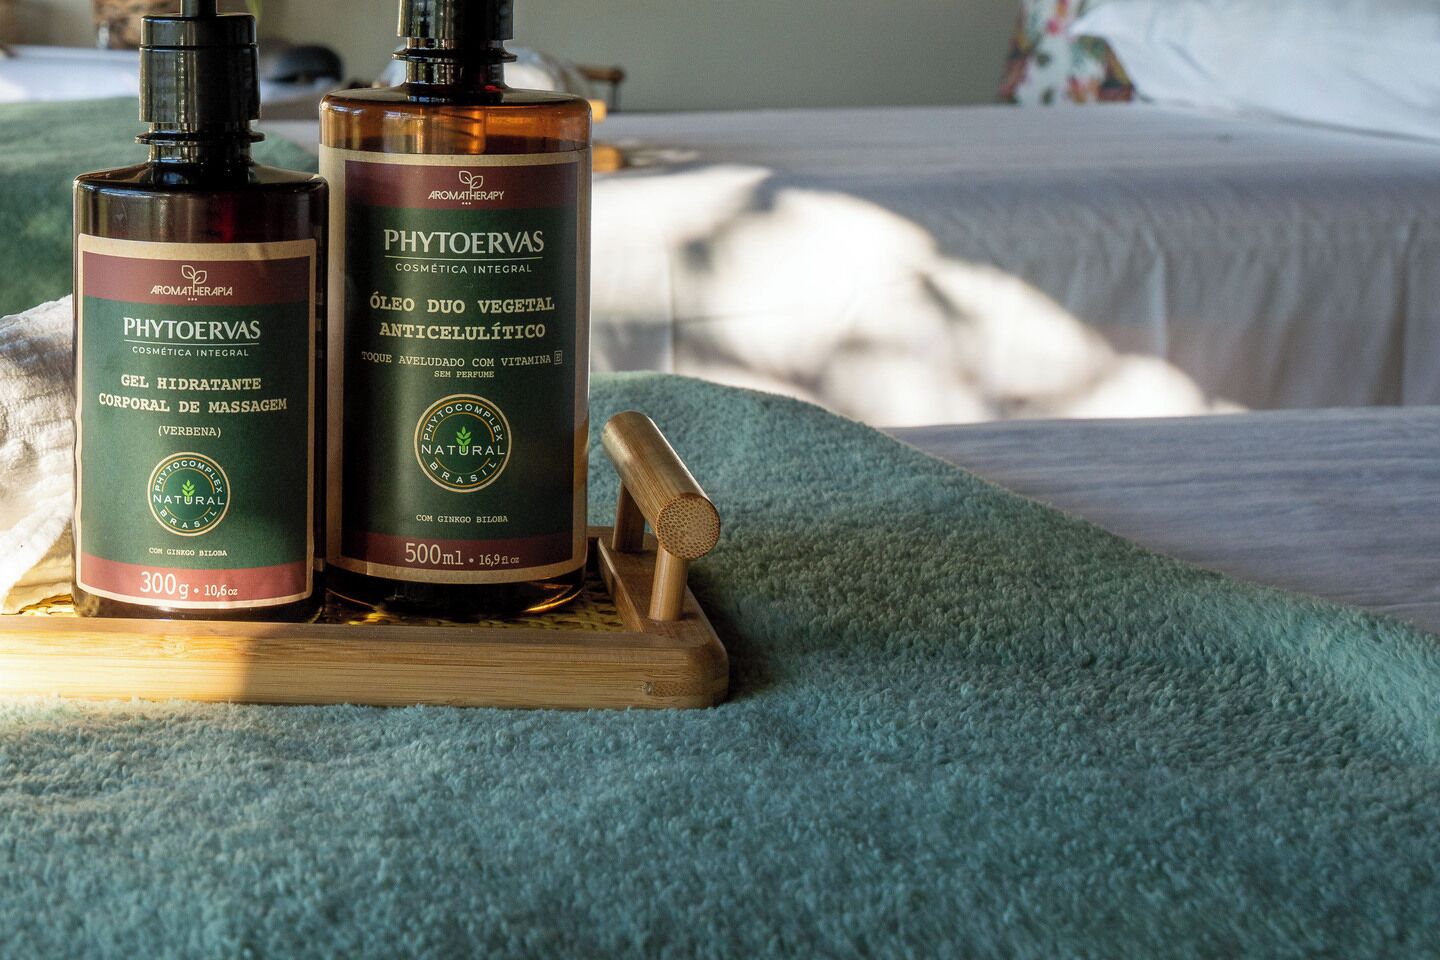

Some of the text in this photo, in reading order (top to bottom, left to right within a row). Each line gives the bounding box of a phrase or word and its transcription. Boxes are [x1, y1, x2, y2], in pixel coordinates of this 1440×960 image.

[428, 191, 505, 201] AROMATHERAPY
[384, 229, 544, 254] PHYTOERVAS
[395, 263, 532, 274] COSMÉTICA INTEGRAL
[150, 284, 233, 297] AROMATHERAPIA
[370, 291, 555, 314] ÓLEO DUO VEGETAL
[123, 317, 261, 340] PHYTOERVAS
[379, 322, 546, 341] ANTICELULÍTICO
[132, 346, 249, 357] COSMÉTICA INTEGRAL
[361, 351, 393, 364] TOQUE
[398, 356, 465, 367] AVELUDADO
[472, 358, 495, 367] COM
[500, 355, 551, 367] VITAMINA
[121, 374, 262, 390] GEL HIDRATANTE
[434, 370, 495, 378] SEM PERFUME
[99, 393, 288, 413] CORPORAL DE MASSAGEM
[424, 404, 503, 441] PHYTOCOMPLEX
[158, 425, 221, 438] (VERBENA)
[421, 444, 505, 456] NATURAL
[155, 460, 223, 493] PHYTOCOMPLEX
[430, 462, 497, 483] BRASIL
[153, 494, 224, 505] NATURAL
[160, 509, 217, 529] BRASIL
[416, 514, 508, 523] COM GINKGO BILOBA
[405, 542, 464, 565] 500ml
